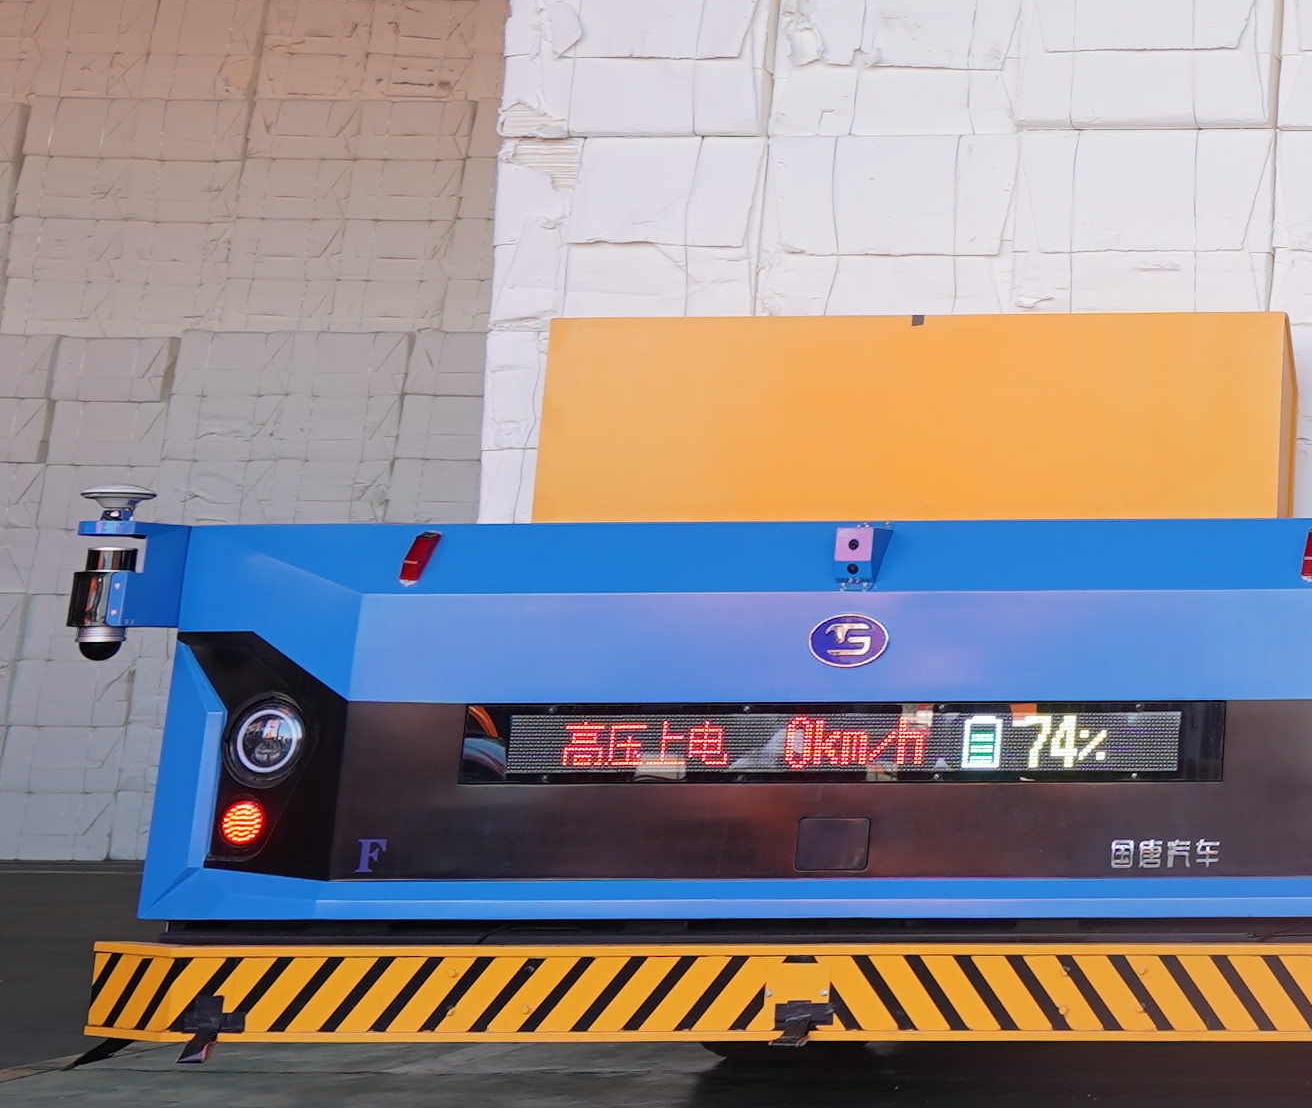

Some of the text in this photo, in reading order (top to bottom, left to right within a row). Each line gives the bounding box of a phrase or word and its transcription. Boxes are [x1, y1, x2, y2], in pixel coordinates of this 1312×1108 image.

[561, 714, 1107, 769] 高压上电 0km/h 74%
[354, 838, 387, 873] F
[1110, 838, 1220, 869] 国唐汽车
